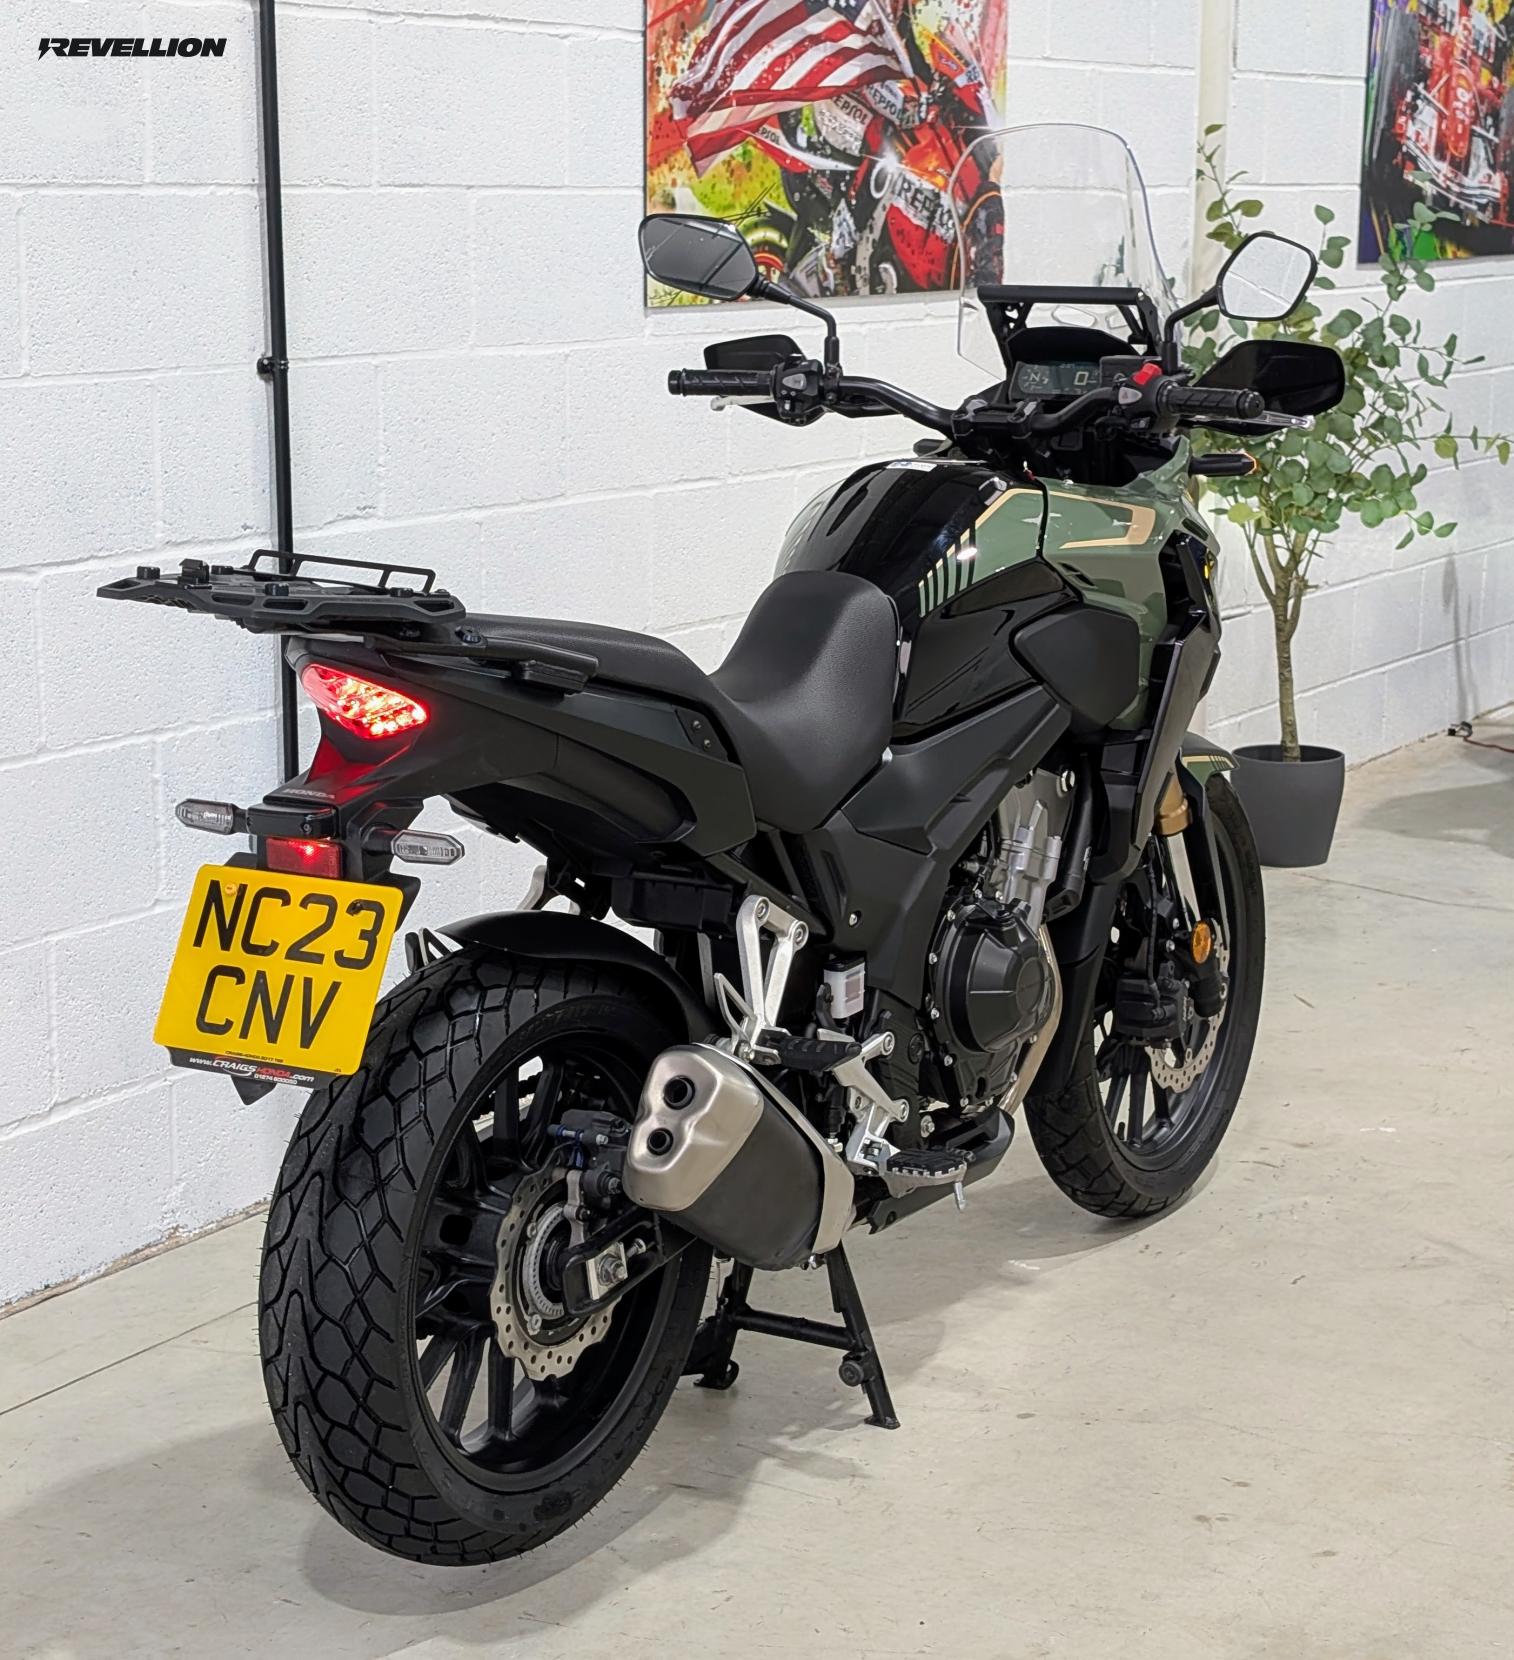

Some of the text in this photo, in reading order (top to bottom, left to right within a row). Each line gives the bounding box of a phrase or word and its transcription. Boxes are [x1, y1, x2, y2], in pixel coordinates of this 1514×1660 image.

[832, 94, 868, 125] EPSOL
[1073, 371, 1089, 386] 0
[282, 788, 336, 799] HONDA
[193, 880, 385, 970] NC23
[196, 965, 342, 1049] CNV
